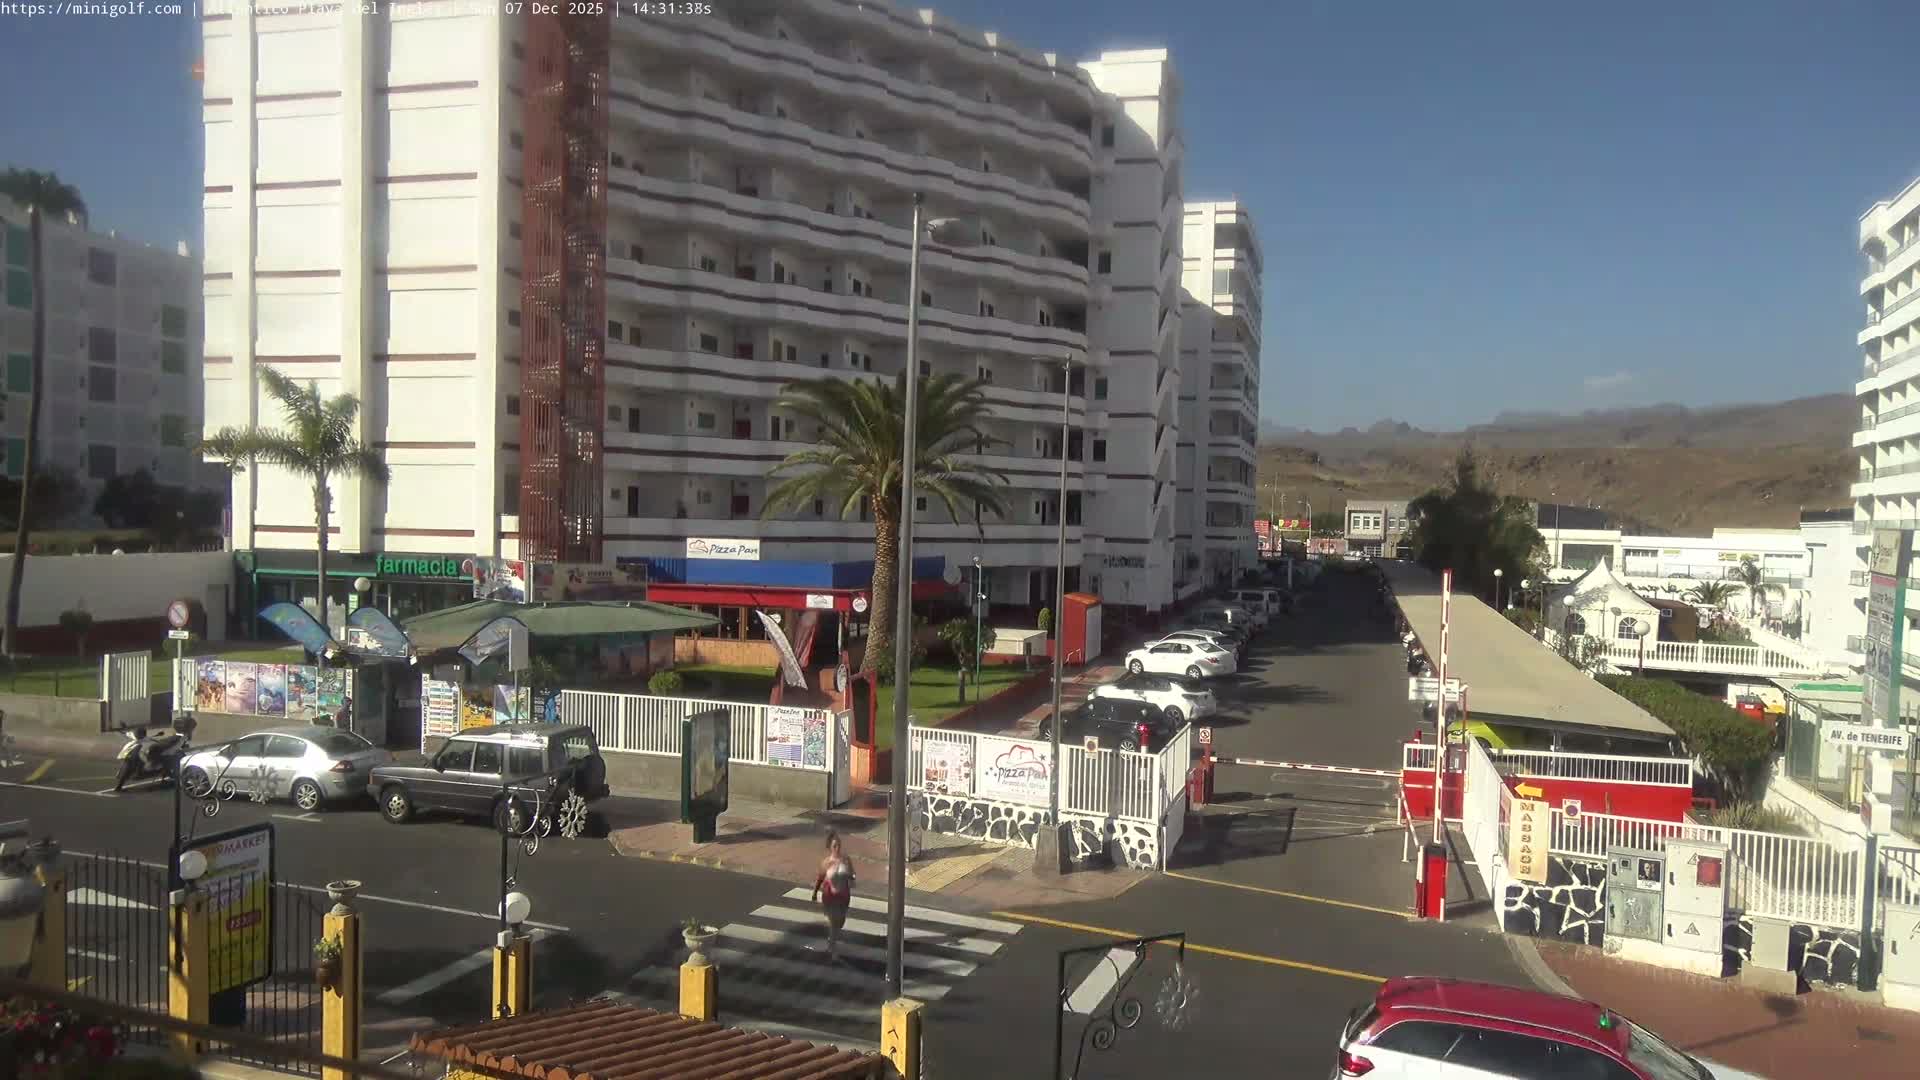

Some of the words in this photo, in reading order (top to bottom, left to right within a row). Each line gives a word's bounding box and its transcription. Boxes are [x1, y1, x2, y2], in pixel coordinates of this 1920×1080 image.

[708, 544, 737, 555] Pizza
[375, 554, 458, 576] farmacia
[1830, 730, 1845, 740] AV.
[1846, 731, 1858, 741] de
[1860, 732, 1903, 746] TENERIFE
